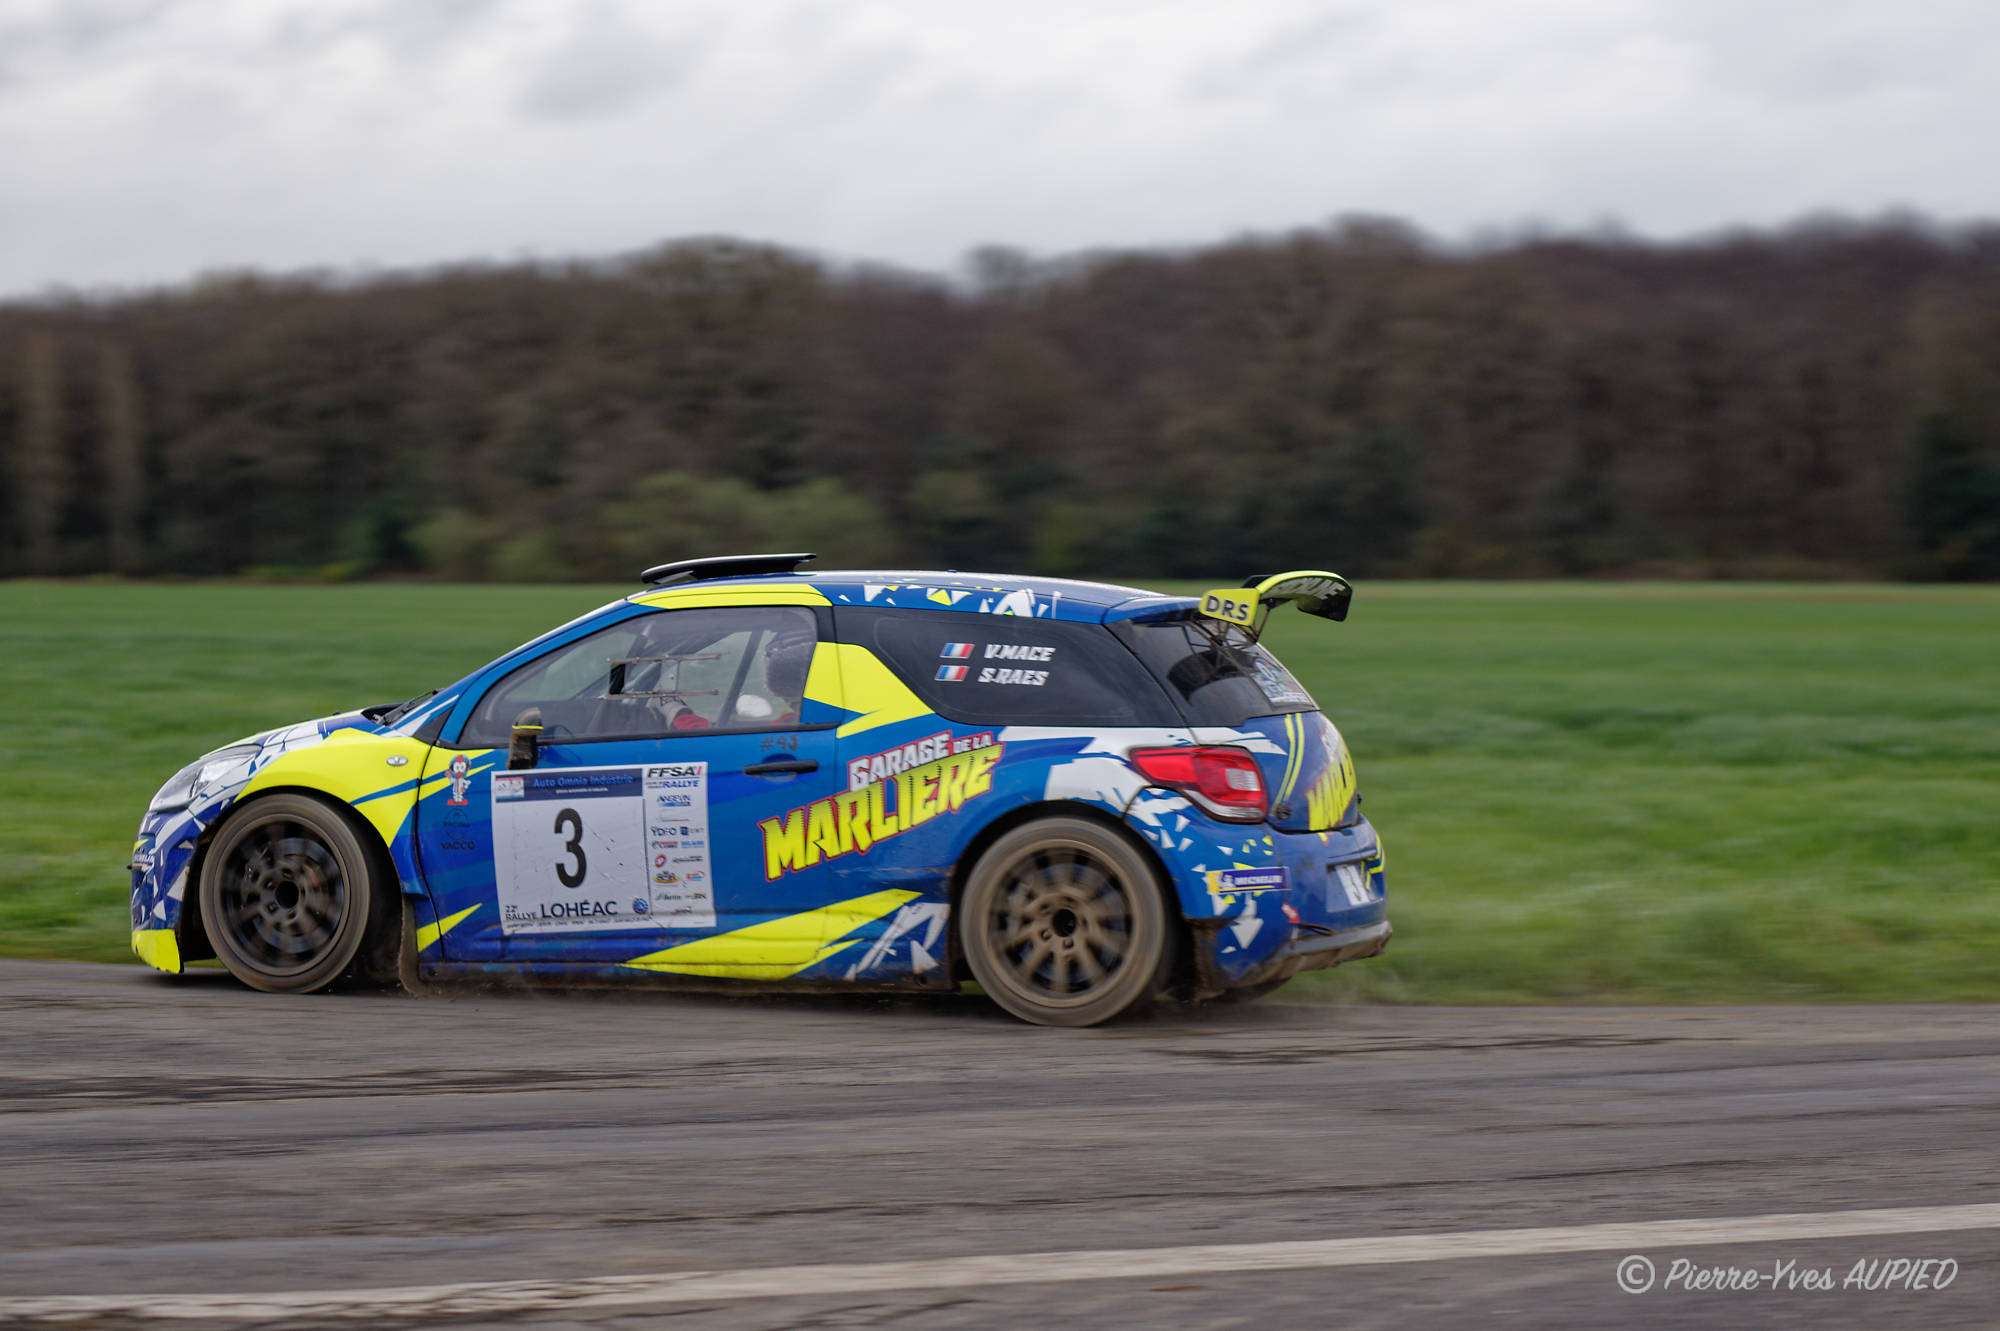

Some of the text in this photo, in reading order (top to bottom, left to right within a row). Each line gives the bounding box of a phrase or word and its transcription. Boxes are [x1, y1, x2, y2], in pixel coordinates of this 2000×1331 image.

[1206, 594, 1249, 621] DRS
[984, 643, 1056, 662] V.MACE
[978, 667, 1049, 686] S.RAES
[849, 731, 993, 791] GARAGE DE LA
[533, 778, 556, 788] Auto
[557, 776, 588, 787] Omnia
[590, 774, 633, 785] Industrie
[647, 766, 696, 778] FFSA
[663, 780, 700, 789] RALLYE
[758, 742, 1005, 881] MARLIERE
[554, 807, 587, 889] 3
[505, 899, 618, 921] RALLYE LOHÉAC
